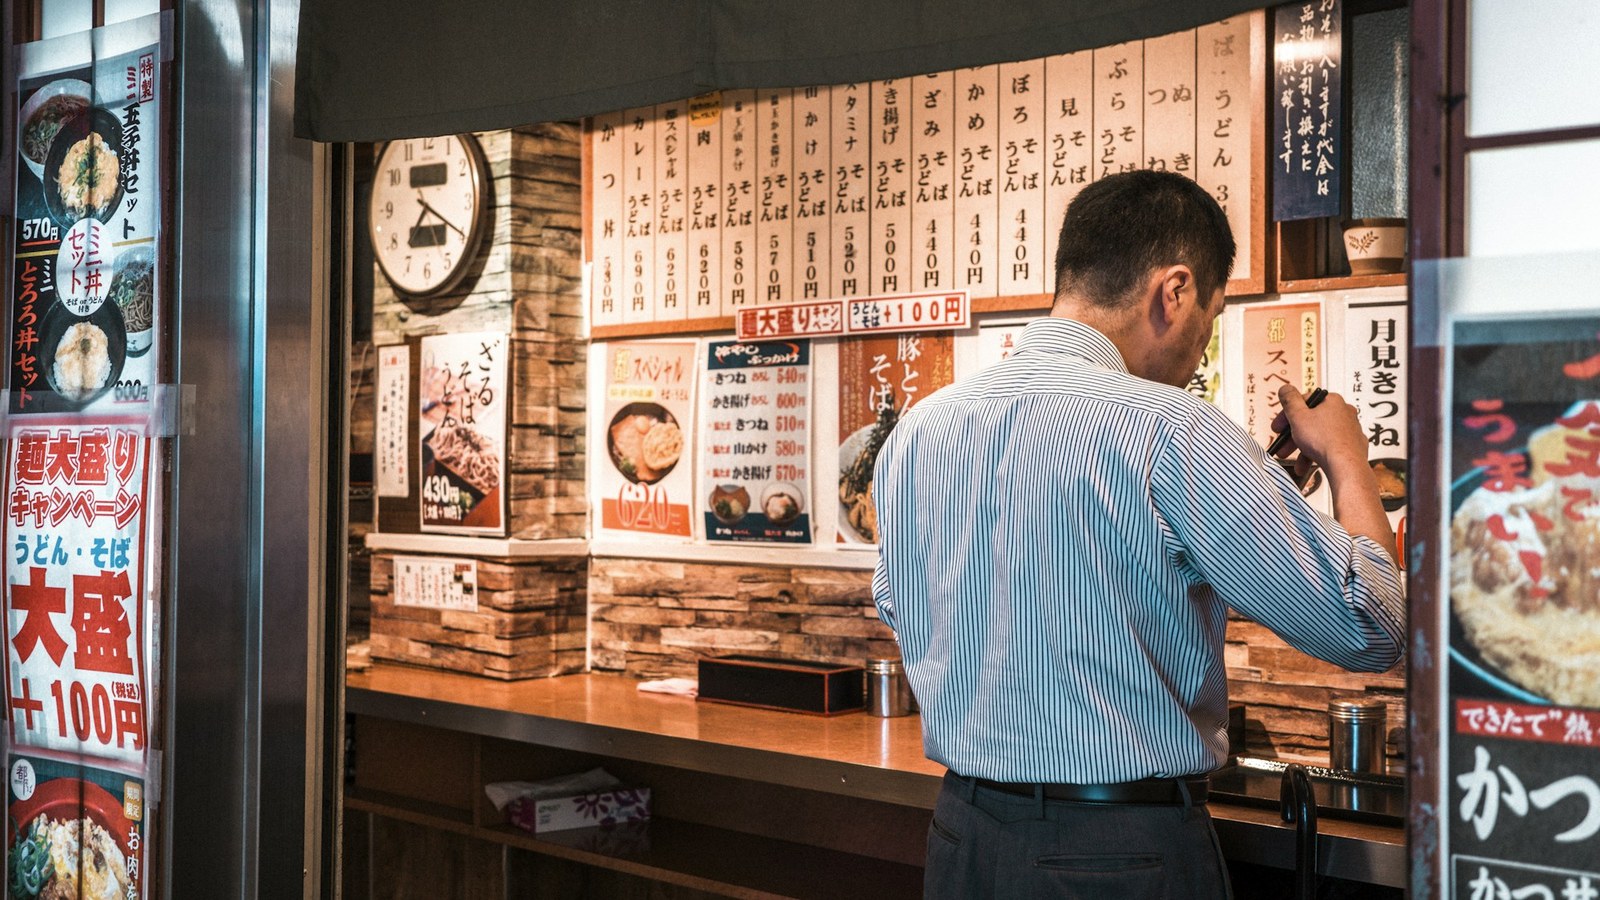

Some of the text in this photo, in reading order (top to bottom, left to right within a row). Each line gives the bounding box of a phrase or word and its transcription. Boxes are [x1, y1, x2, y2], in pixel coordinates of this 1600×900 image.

[141, 58, 153, 99] 特製
[404, 143, 413, 161] 11
[460, 158, 466, 176] 2
[1004, 141, 1020, 193] うどん
[1022, 138, 1039, 190] そば
[1050, 134, 1067, 187] うどん
[1070, 130, 1087, 184] そば
[388, 168, 401, 187] 10
[761, 176, 774, 222] うどん
[775, 174, 788, 220] そば
[797, 172, 811, 218] うどん
[812, 169, 826, 216] そば
[835, 166, 849, 214] うどん
[851, 164, 866, 212] そば
[875, 161, 889, 210] うどん
[891, 158, 906, 208] そば
[916, 74, 948, 288] ざみ そば うどん 440円
[959, 67, 993, 285] かめ そば うどん 440円
[386, 201, 394, 219] 9
[465, 193, 472, 210] 3
[627, 116, 651, 311] カレー そば うどん 690円
[659, 190, 670, 234] うどん
[672, 188, 683, 232] そば
[691, 129, 717, 305] 肉 そば うどん 620円
[725, 183, 738, 228] うどん
[739, 180, 752, 225] そば
[23, 217, 58, 240] 570円
[391, 233, 398, 249] 8
[1013, 208, 1029, 281] 440円
[40, 258, 54, 293] ミニ
[68, 228, 85, 295] セット
[84, 225, 103, 297] ミニ丼
[405, 255, 412, 273] 7
[424, 263, 431, 279] 6
[444, 253, 451, 270] 5
[665, 248, 677, 308] 620円
[732, 241, 744, 305] 580円
[768, 235, 781, 300] 570円
[804, 232, 818, 298] 510円
[883, 223, 897, 292] 500円
[852, 301, 880, 315] うどん
[15, 260, 39, 408] とろろ丼セット
[441, 362, 457, 428] うどん
[459, 361, 477, 425] そば
[479, 340, 500, 406] ざる
[716, 371, 746, 385] きつね
[777, 367, 806, 384] 540円
[869, 353, 892, 412] そば
[1368, 318, 1400, 447] 月見きつね
[712, 393, 750, 409] かき揚げ
[736, 417, 768, 431] きつね
[776, 415, 805, 432] 510円
[15, 428, 140, 487] 麺大盛り
[732, 465, 771, 480] かき揚げ
[776, 464, 805, 481] 570円
[734, 443, 768, 455] 山かけ
[9, 486, 142, 530] キャンペーン
[423, 475, 460, 504] 430円
[15, 534, 131, 569] うどん・そば
[11, 566, 134, 676] 大盛
